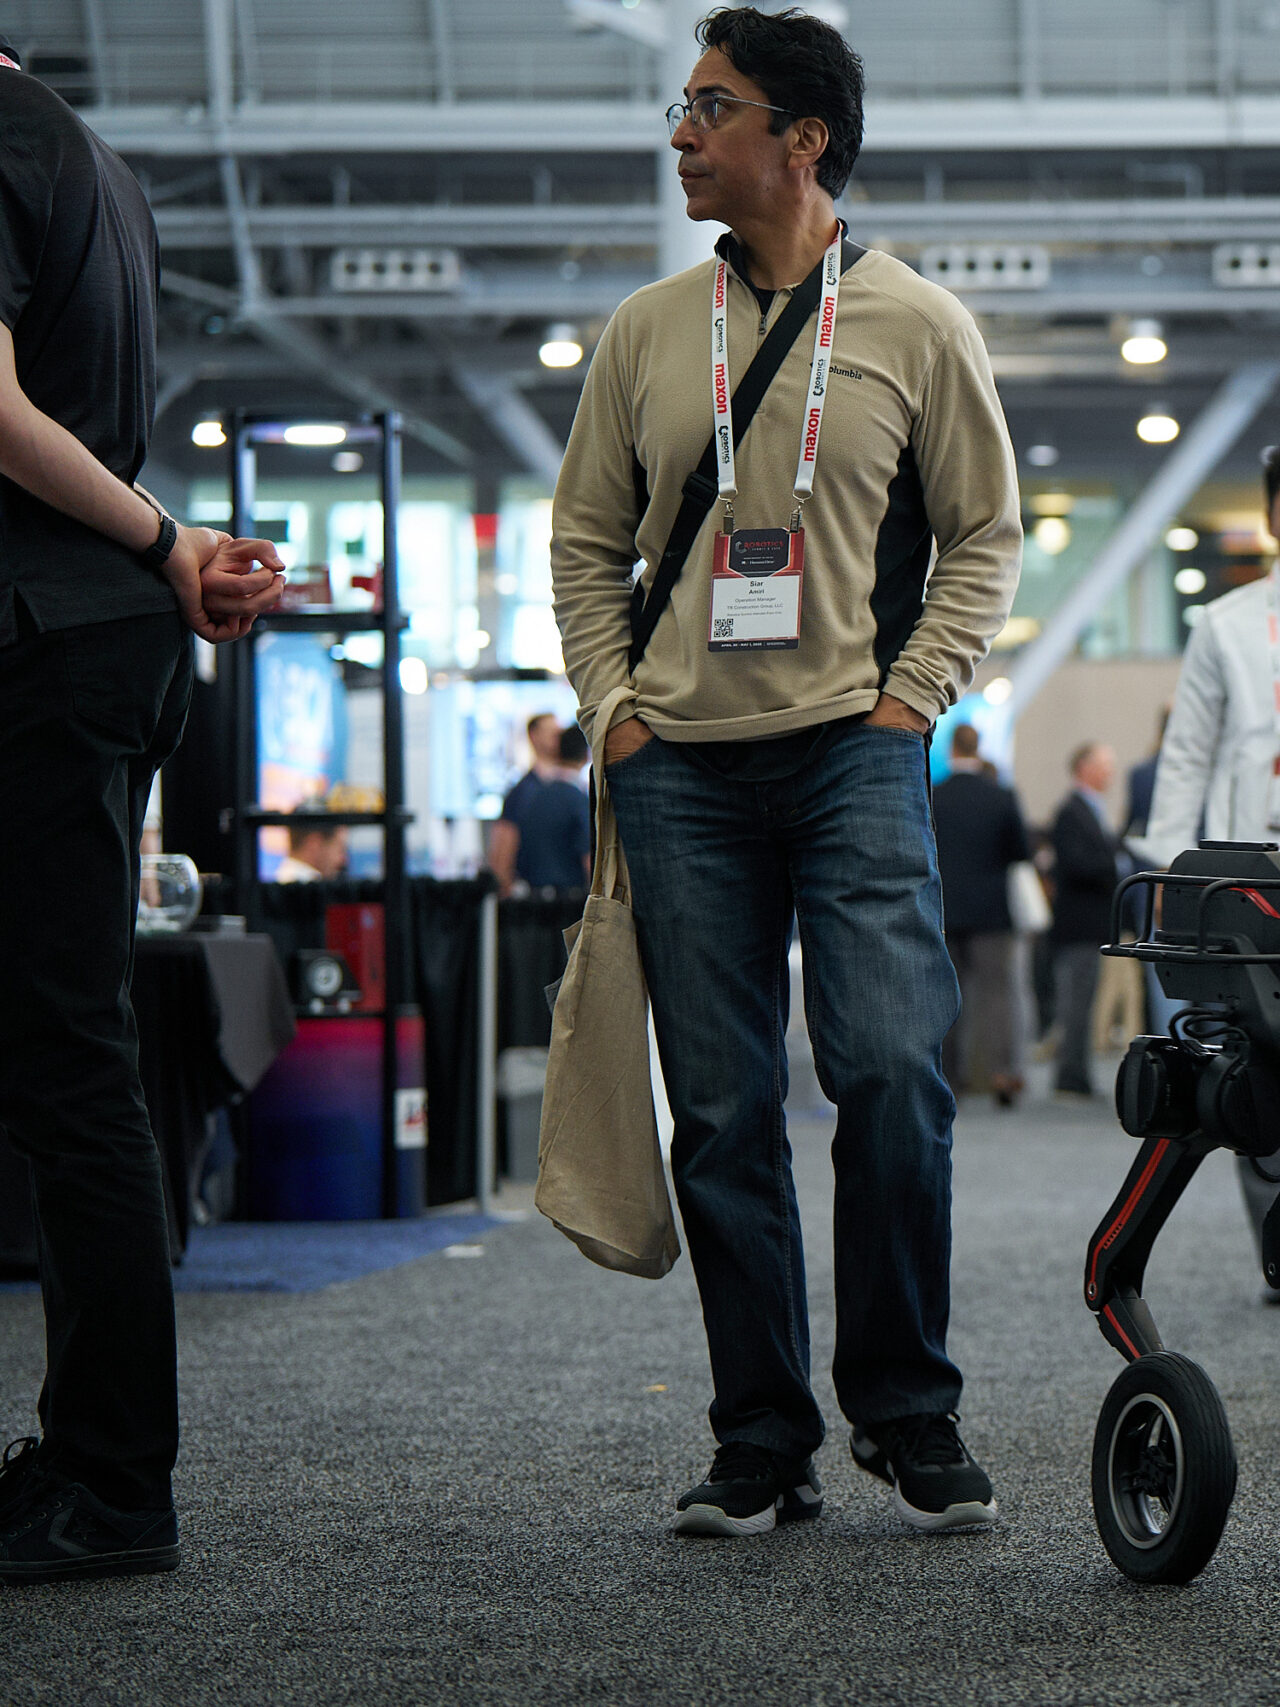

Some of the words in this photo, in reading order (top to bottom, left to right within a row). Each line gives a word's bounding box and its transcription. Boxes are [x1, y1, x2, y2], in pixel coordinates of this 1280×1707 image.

[716, 262, 726, 308] maxon
[819, 297, 835, 347] maxon
[715, 363, 728, 414] maxon
[815, 359, 824, 389] ROBOTICS
[829, 366, 862, 380] olumbia
[721, 432, 730, 464] ROBOTICS
[804, 408, 821, 462] maxon
